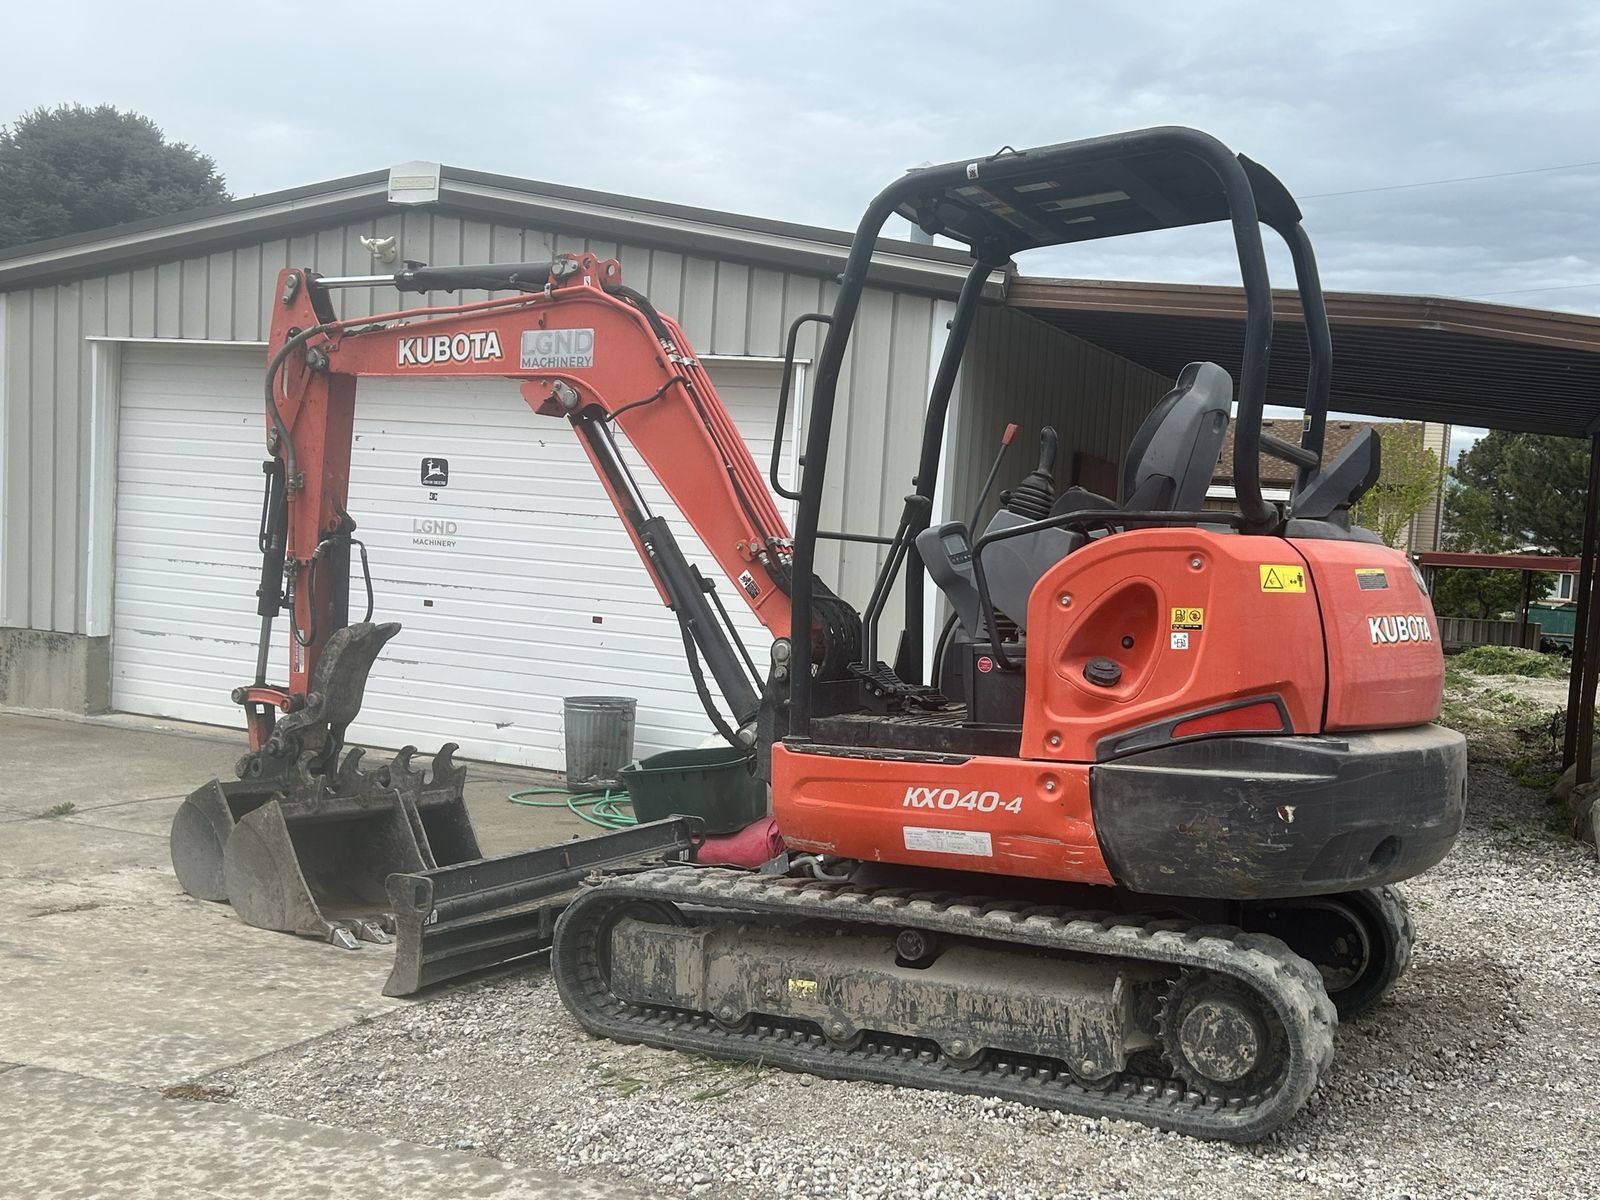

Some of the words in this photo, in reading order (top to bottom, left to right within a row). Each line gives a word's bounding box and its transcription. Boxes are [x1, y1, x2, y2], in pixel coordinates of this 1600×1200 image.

[398, 331, 502, 365] KUBOTA
[522, 330, 593, 356] LGND
[521, 356, 592, 368] MACHINERY
[413, 518, 457, 535] LGND
[413, 538, 456, 547] MACHINERY
[1368, 615, 1432, 644] KUBOTA
[903, 786, 1023, 814] KX040-4
